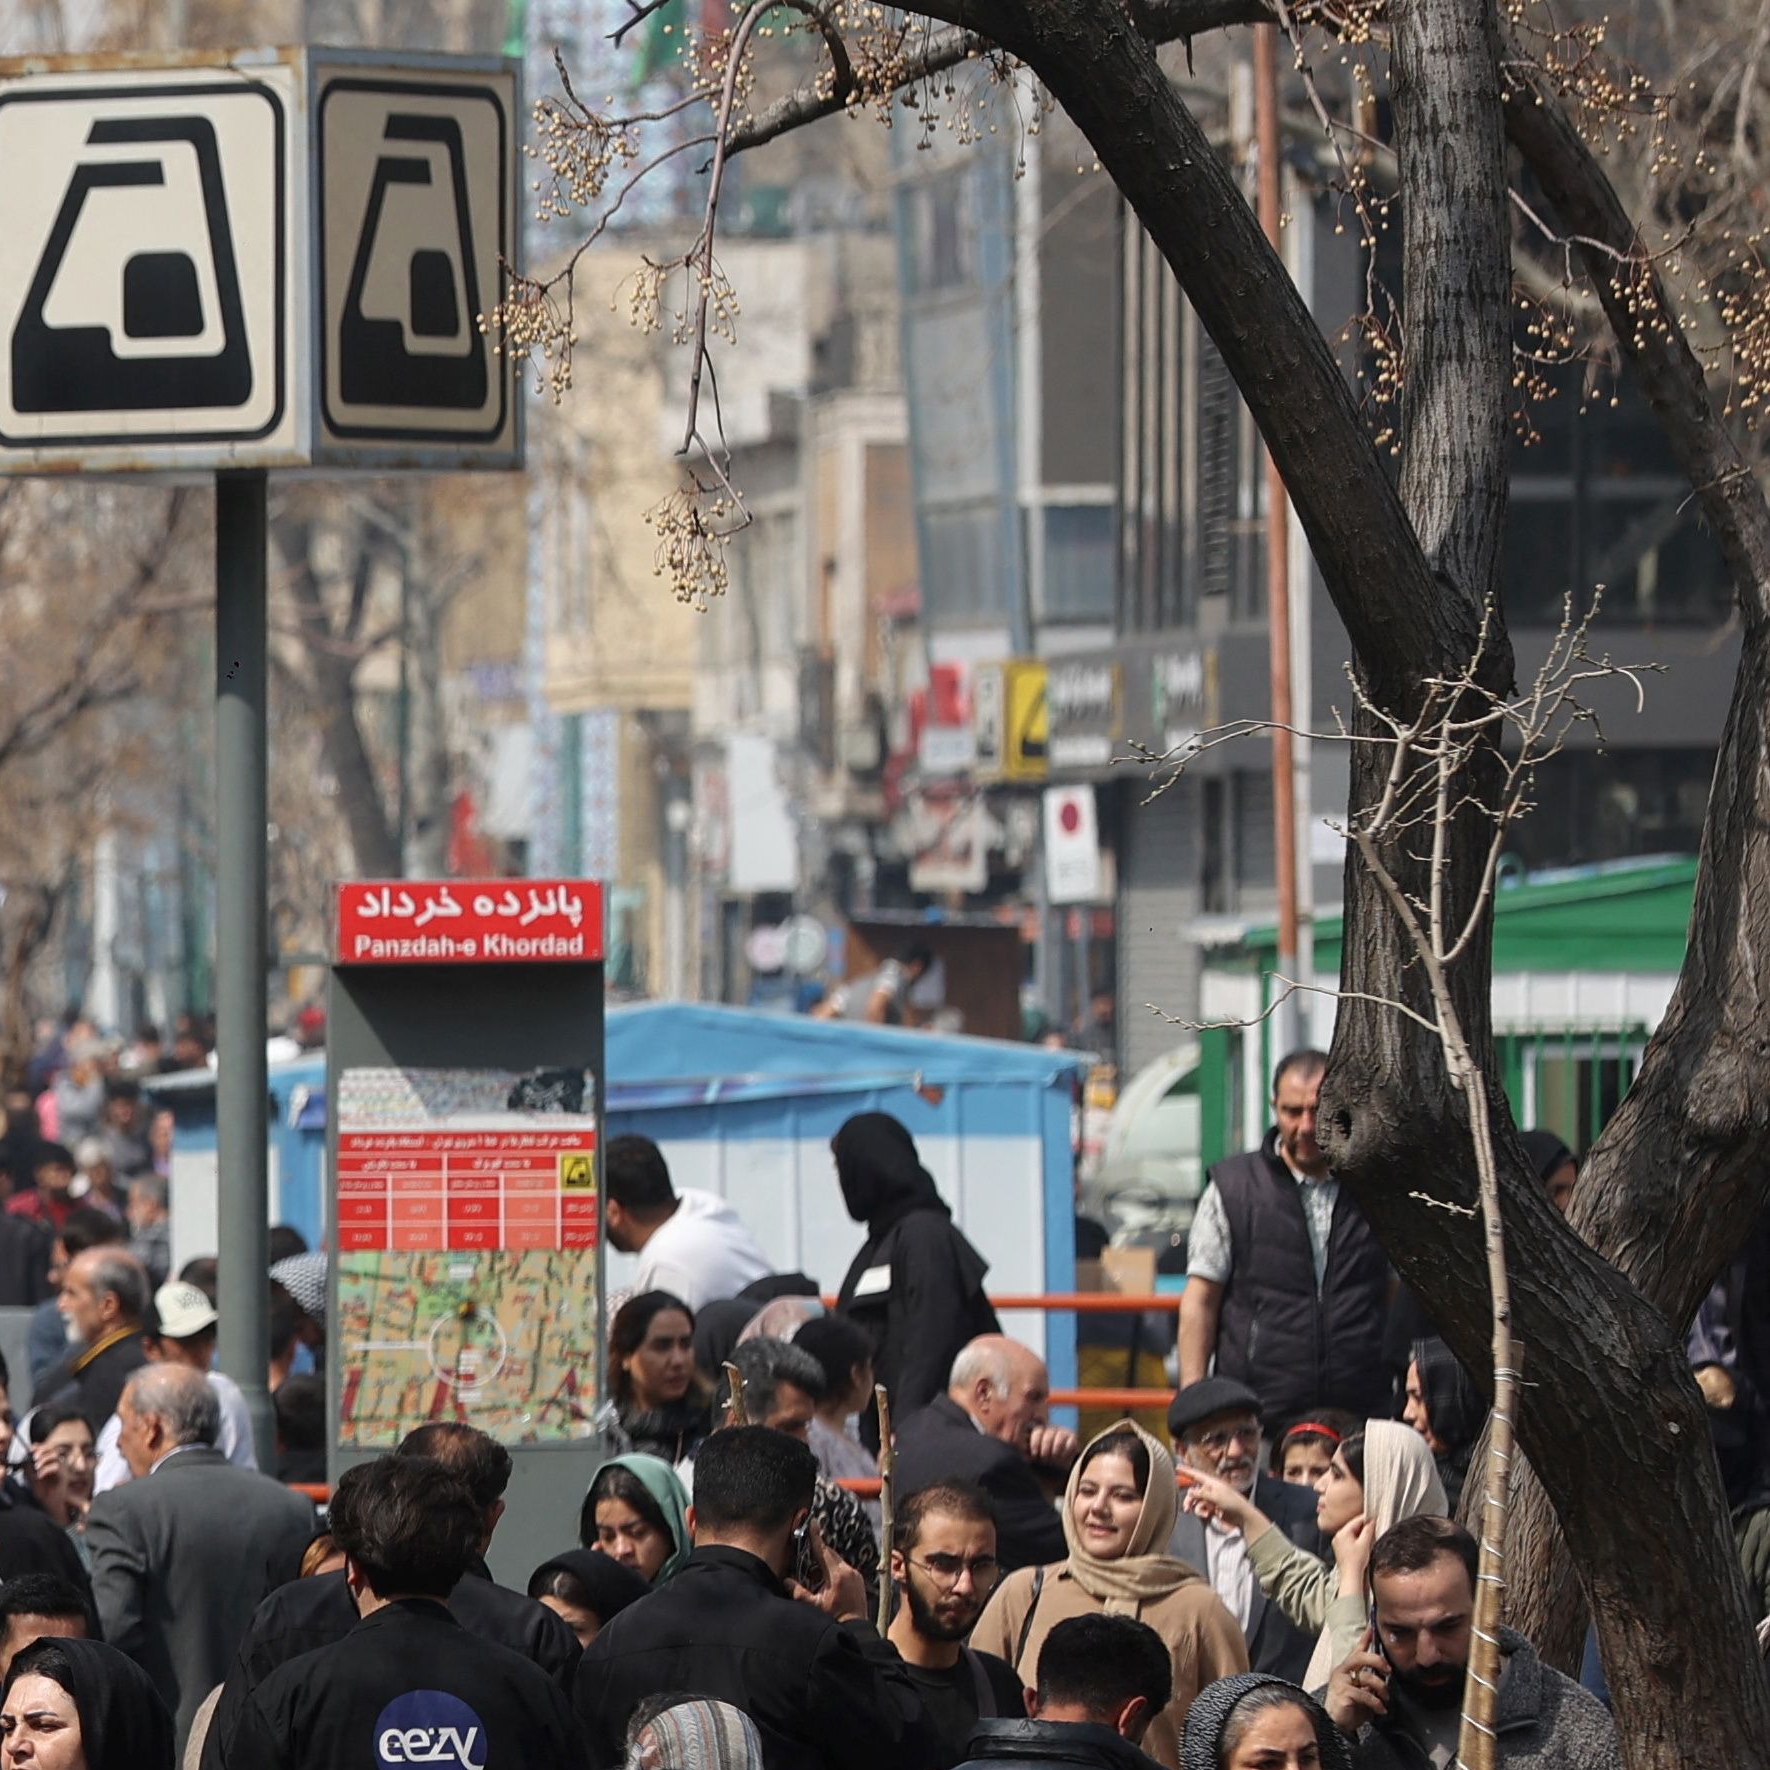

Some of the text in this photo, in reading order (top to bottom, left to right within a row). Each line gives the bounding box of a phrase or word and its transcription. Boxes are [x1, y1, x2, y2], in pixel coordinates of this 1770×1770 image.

[356, 885, 583, 928] پانزده خرداد
[354, 933, 584, 957] Panzdah-e Khordad
